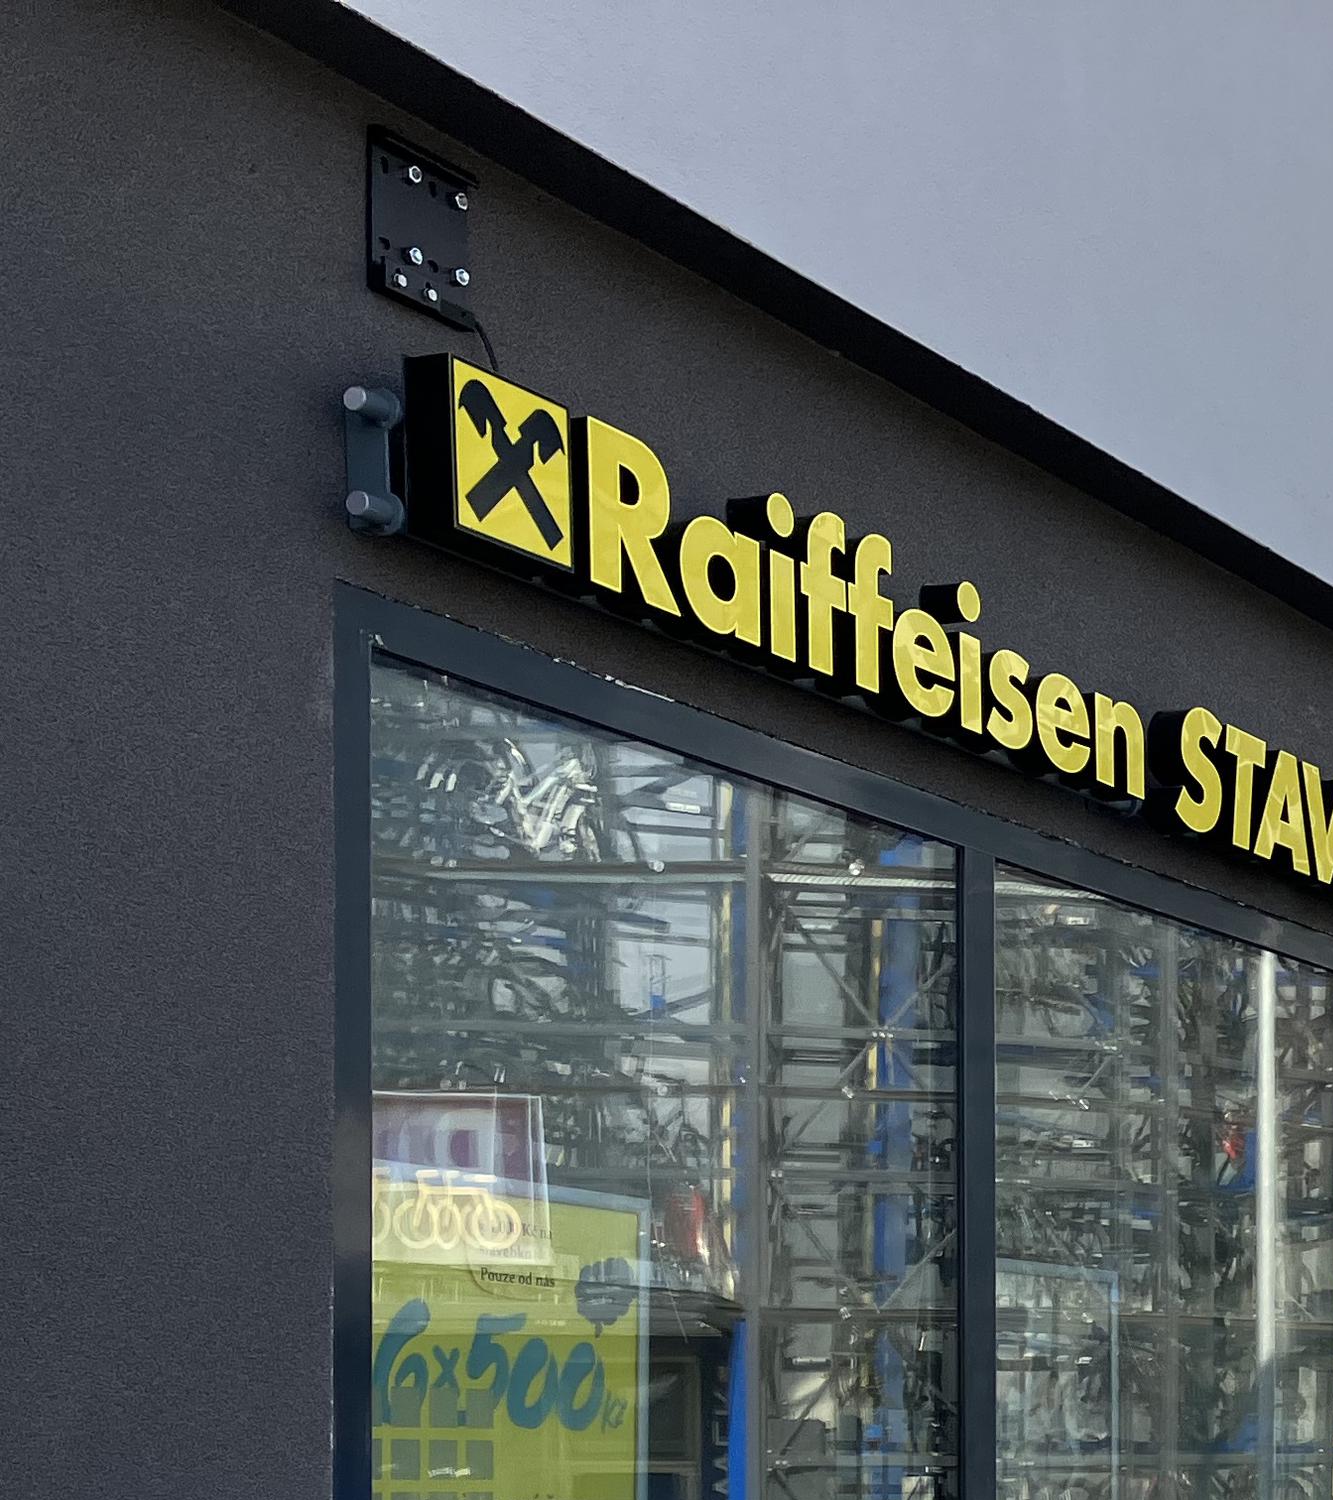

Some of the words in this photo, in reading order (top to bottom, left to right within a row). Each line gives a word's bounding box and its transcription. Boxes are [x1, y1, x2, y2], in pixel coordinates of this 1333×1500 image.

[588, 415, 1146, 801] Raiffeisen
[480, 1266, 516, 1284] Pouze
[518, 1271, 532, 1286] od
[535, 1274, 556, 1288] nás
